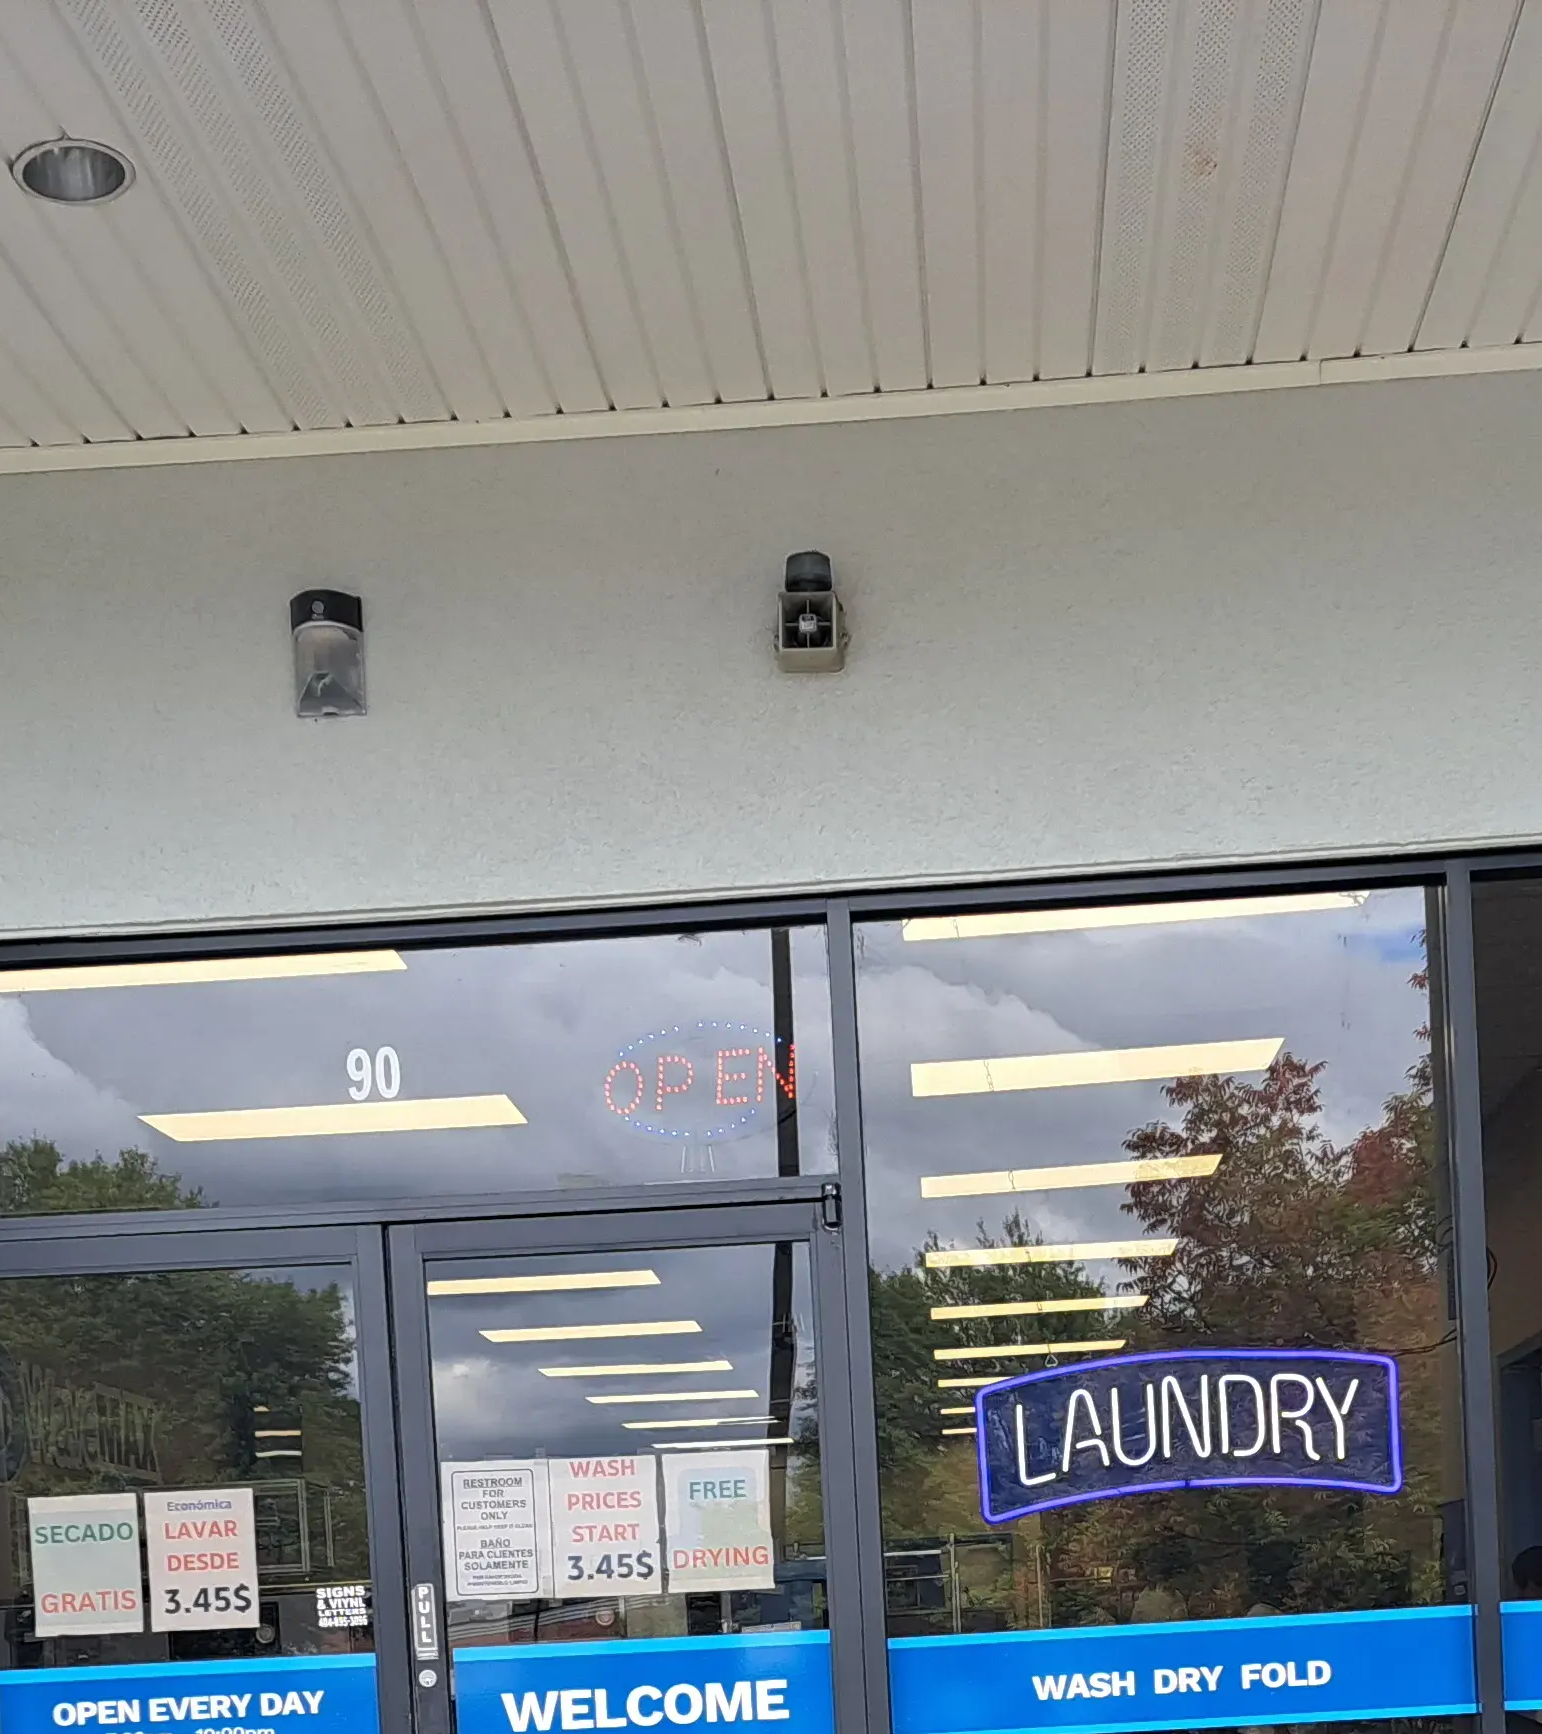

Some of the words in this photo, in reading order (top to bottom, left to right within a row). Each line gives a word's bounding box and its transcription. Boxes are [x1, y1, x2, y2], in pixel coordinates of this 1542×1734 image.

[347, 1045, 401, 1101] 90
[603, 1042, 796, 1116] OPEN
[1015, 1372, 1359, 1487] LAUNDRY
[569, 1458, 636, 1480] WASH
[463, 1476, 523, 1489] RESTROOM
[482, 1489, 504, 1498] FOR
[688, 1479, 748, 1501] FREE
[166, 1498, 233, 1513] Económica
[461, 1499, 527, 1510] CUSTOMERS
[566, 1490, 643, 1513] PRICES
[480, 1511, 508, 1521] ONLY
[34, 1522, 134, 1546] SECADO
[164, 1519, 238, 1541] LAVAR
[571, 1523, 640, 1544] START
[167, 1552, 240, 1573] DESDE
[458, 1550, 485, 1560] PARA
[486, 1548, 534, 1559] CLIENTES
[673, 1545, 770, 1571] DRYING
[464, 1560, 529, 1571] SOLAMENTE
[566, 1549, 655, 1582] 3.45$
[41, 1589, 137, 1615] GRATIS
[164, 1583, 253, 1615] 3.45$
[316, 1585, 366, 1599] SIGNS
[318, 1607, 367, 1617] LETTERS
[417, 1586, 432, 1643] PULL
[1032, 1670, 1136, 1702] WASH
[1154, 1665, 1224, 1696] DRY
[1241, 1660, 1332, 1690] FOLD
[52, 1698, 141, 1728] OPEN
[149, 1693, 253, 1722] EVERY
[260, 1690, 326, 1716] DAY
[501, 1679, 790, 1733] WELCOME
